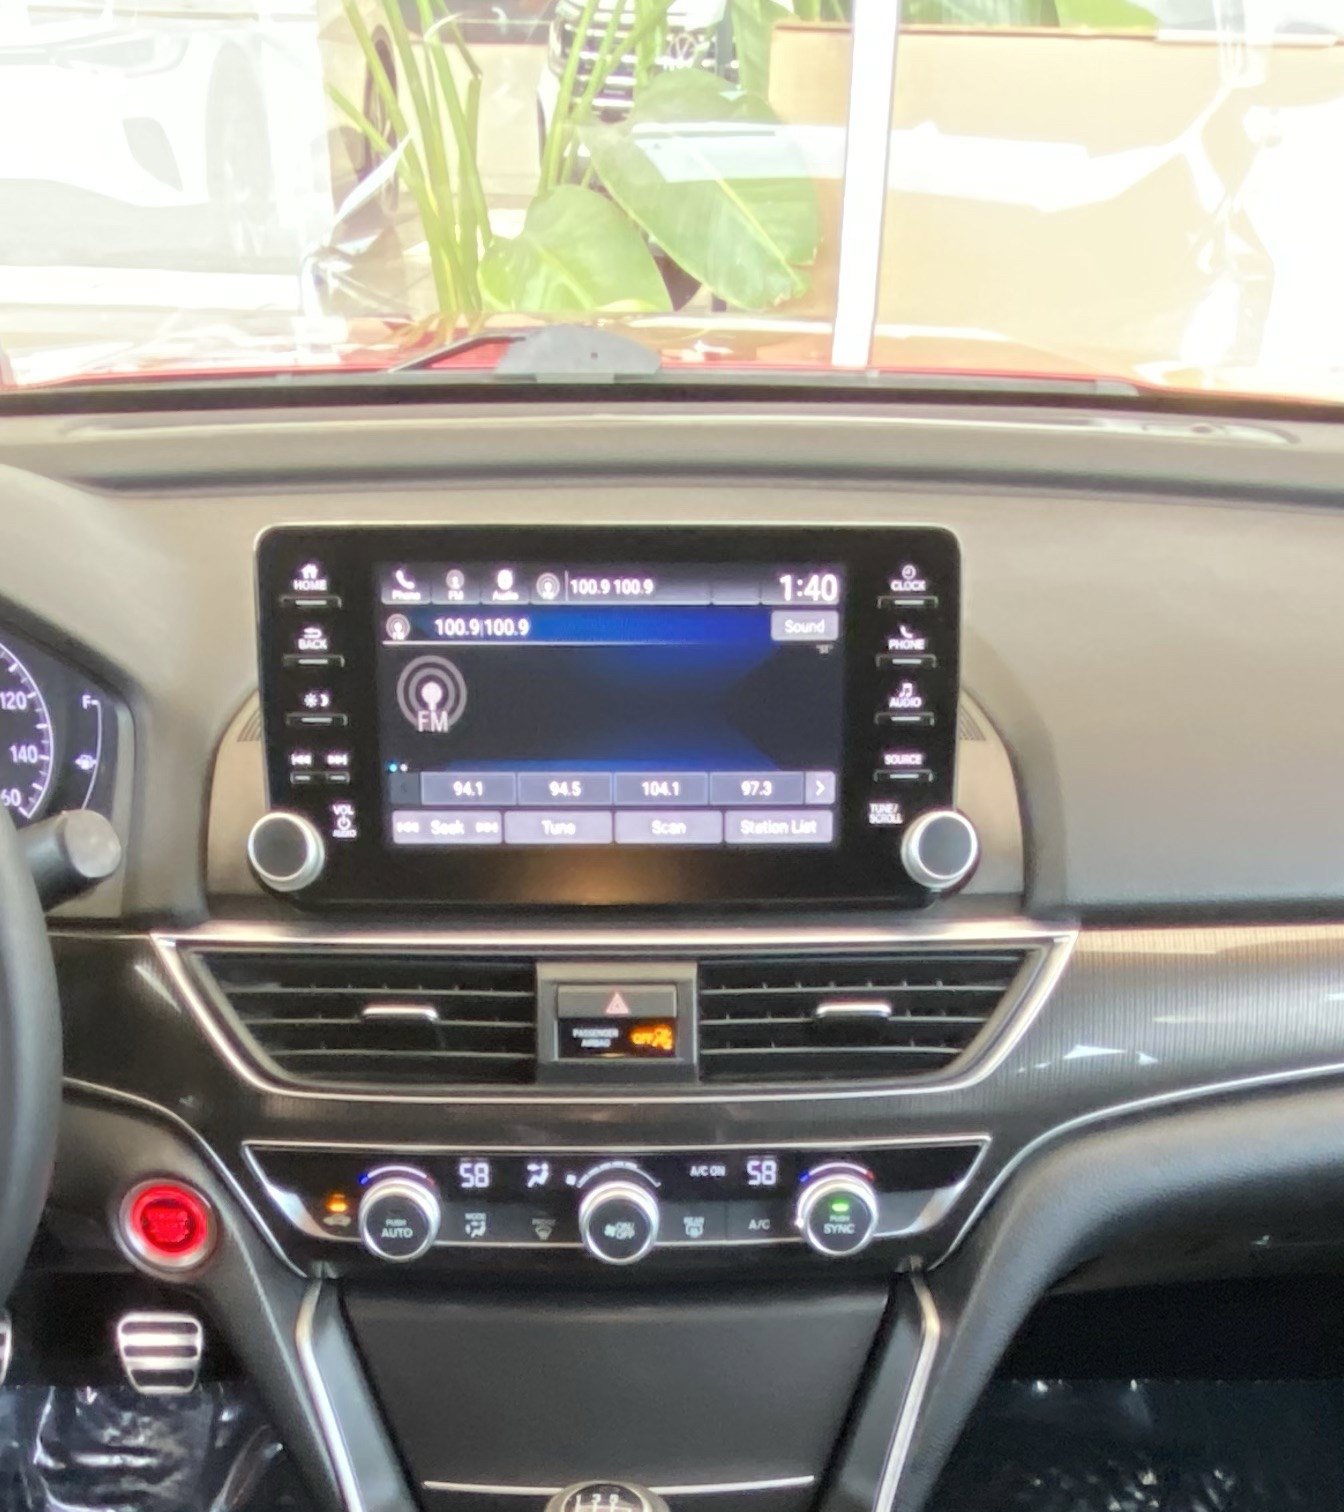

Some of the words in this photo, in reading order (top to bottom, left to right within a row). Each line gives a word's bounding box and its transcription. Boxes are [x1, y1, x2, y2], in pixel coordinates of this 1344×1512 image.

[294, 580, 327, 591] HOME
[570, 579, 610, 594] 100.9
[613, 579, 654, 594] 100.9
[780, 574, 838, 601] 1:40
[891, 580, 927, 592] CLOCK
[434, 618, 480, 636] 100.9
[484, 618, 530, 636] 100.9
[785, 619, 825, 634] Sound
[298, 638, 328, 650] BACK
[888, 638, 925, 650] PHONE
[889, 697, 922, 708] AUDIO
[417, 711, 449, 732] FM
[10, 744, 39, 764] 140
[884, 754, 922, 765] SOURCE
[453, 780, 484, 797] 94.1
[549, 780, 582, 797] 94.5
[642, 780, 680, 797] 104.1
[741, 780, 773, 797] 97.3
[1, 789, 21, 806] 60
[333, 804, 354, 815] VOL
[541, 820, 577, 835] Tune
[651, 819, 687, 834] Scan
[740, 819, 788, 834] Station
[791, 819, 817, 834] List
[460, 1162, 490, 1188] 58
[747, 1160, 777, 1186] 58
[748, 1219, 770, 1230] A/C
[823, 1222, 855, 1235] SYNC
[381, 1227, 414, 1239] AUTO
